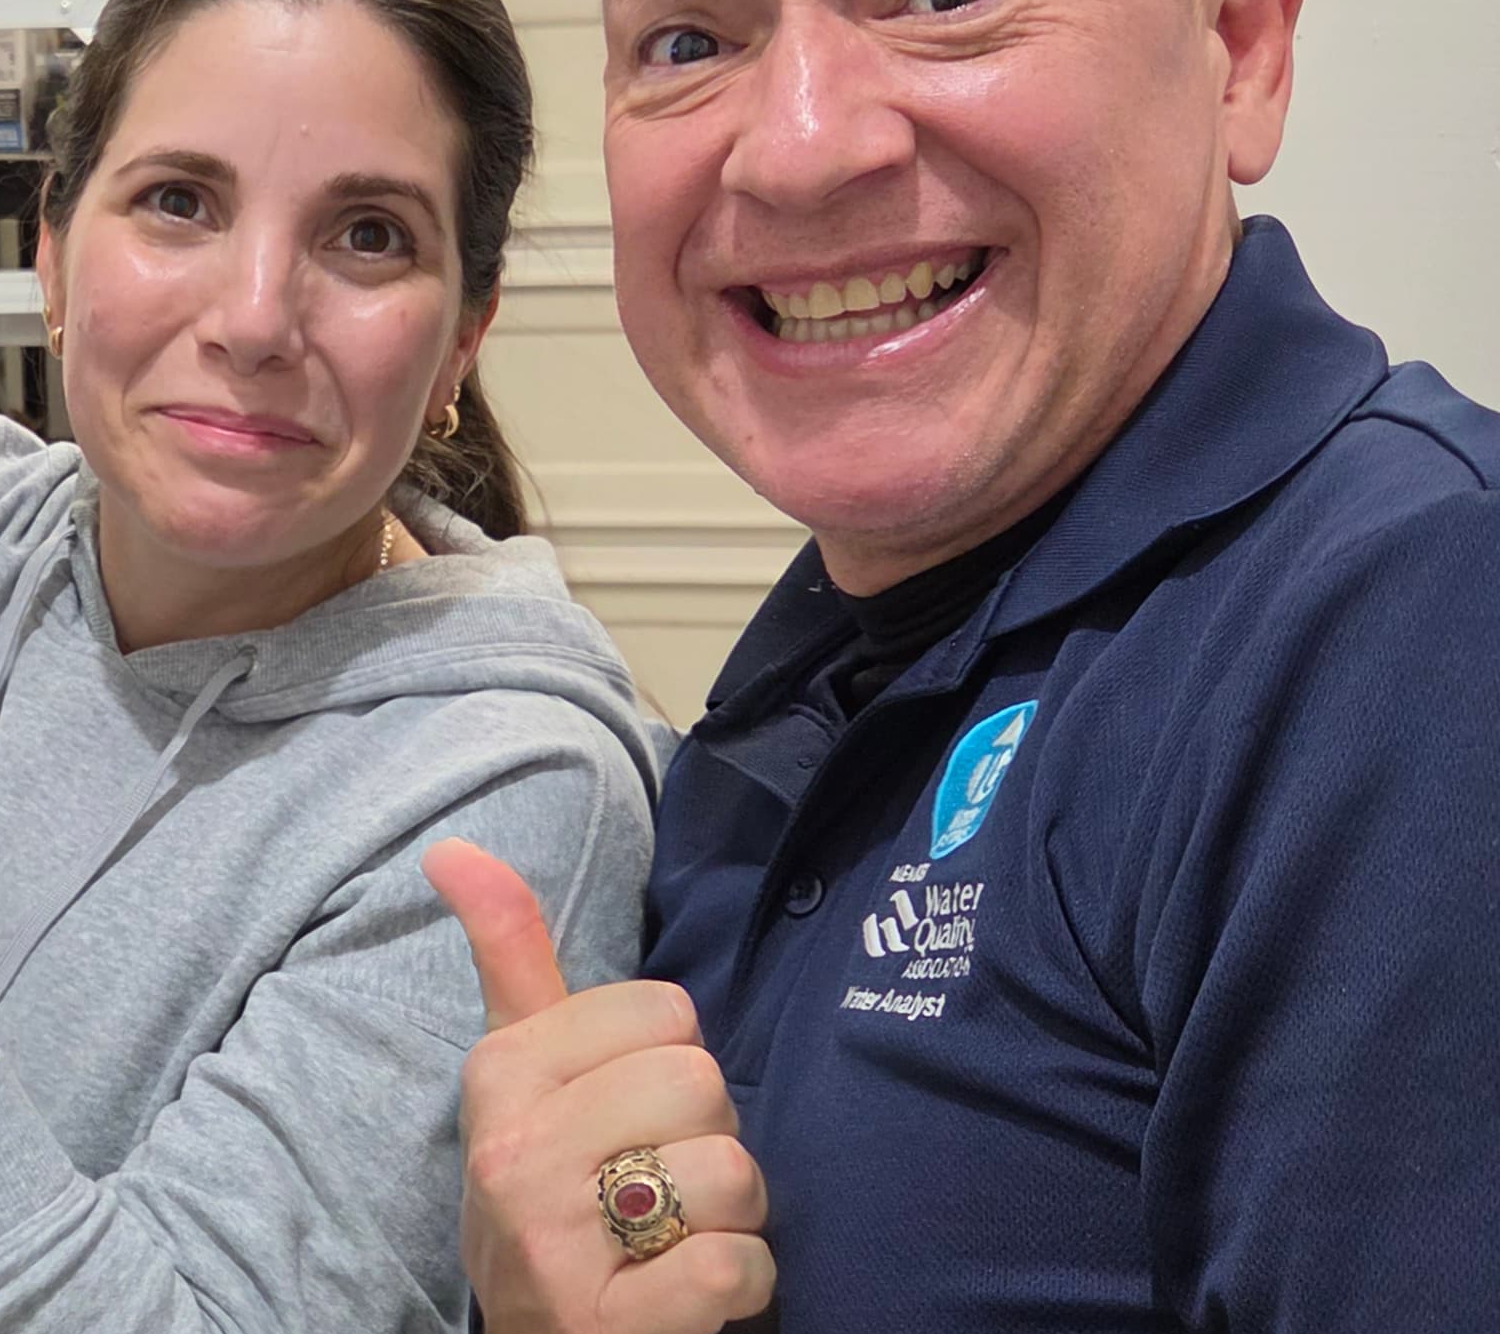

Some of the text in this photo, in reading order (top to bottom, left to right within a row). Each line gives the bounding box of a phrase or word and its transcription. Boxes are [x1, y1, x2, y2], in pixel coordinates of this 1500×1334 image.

[925, 882, 985, 918] Water
[914, 915, 976, 957] Quality
[901, 956, 971, 980] ASSOCIATION
[839, 985, 947, 1022] Water Analyst
